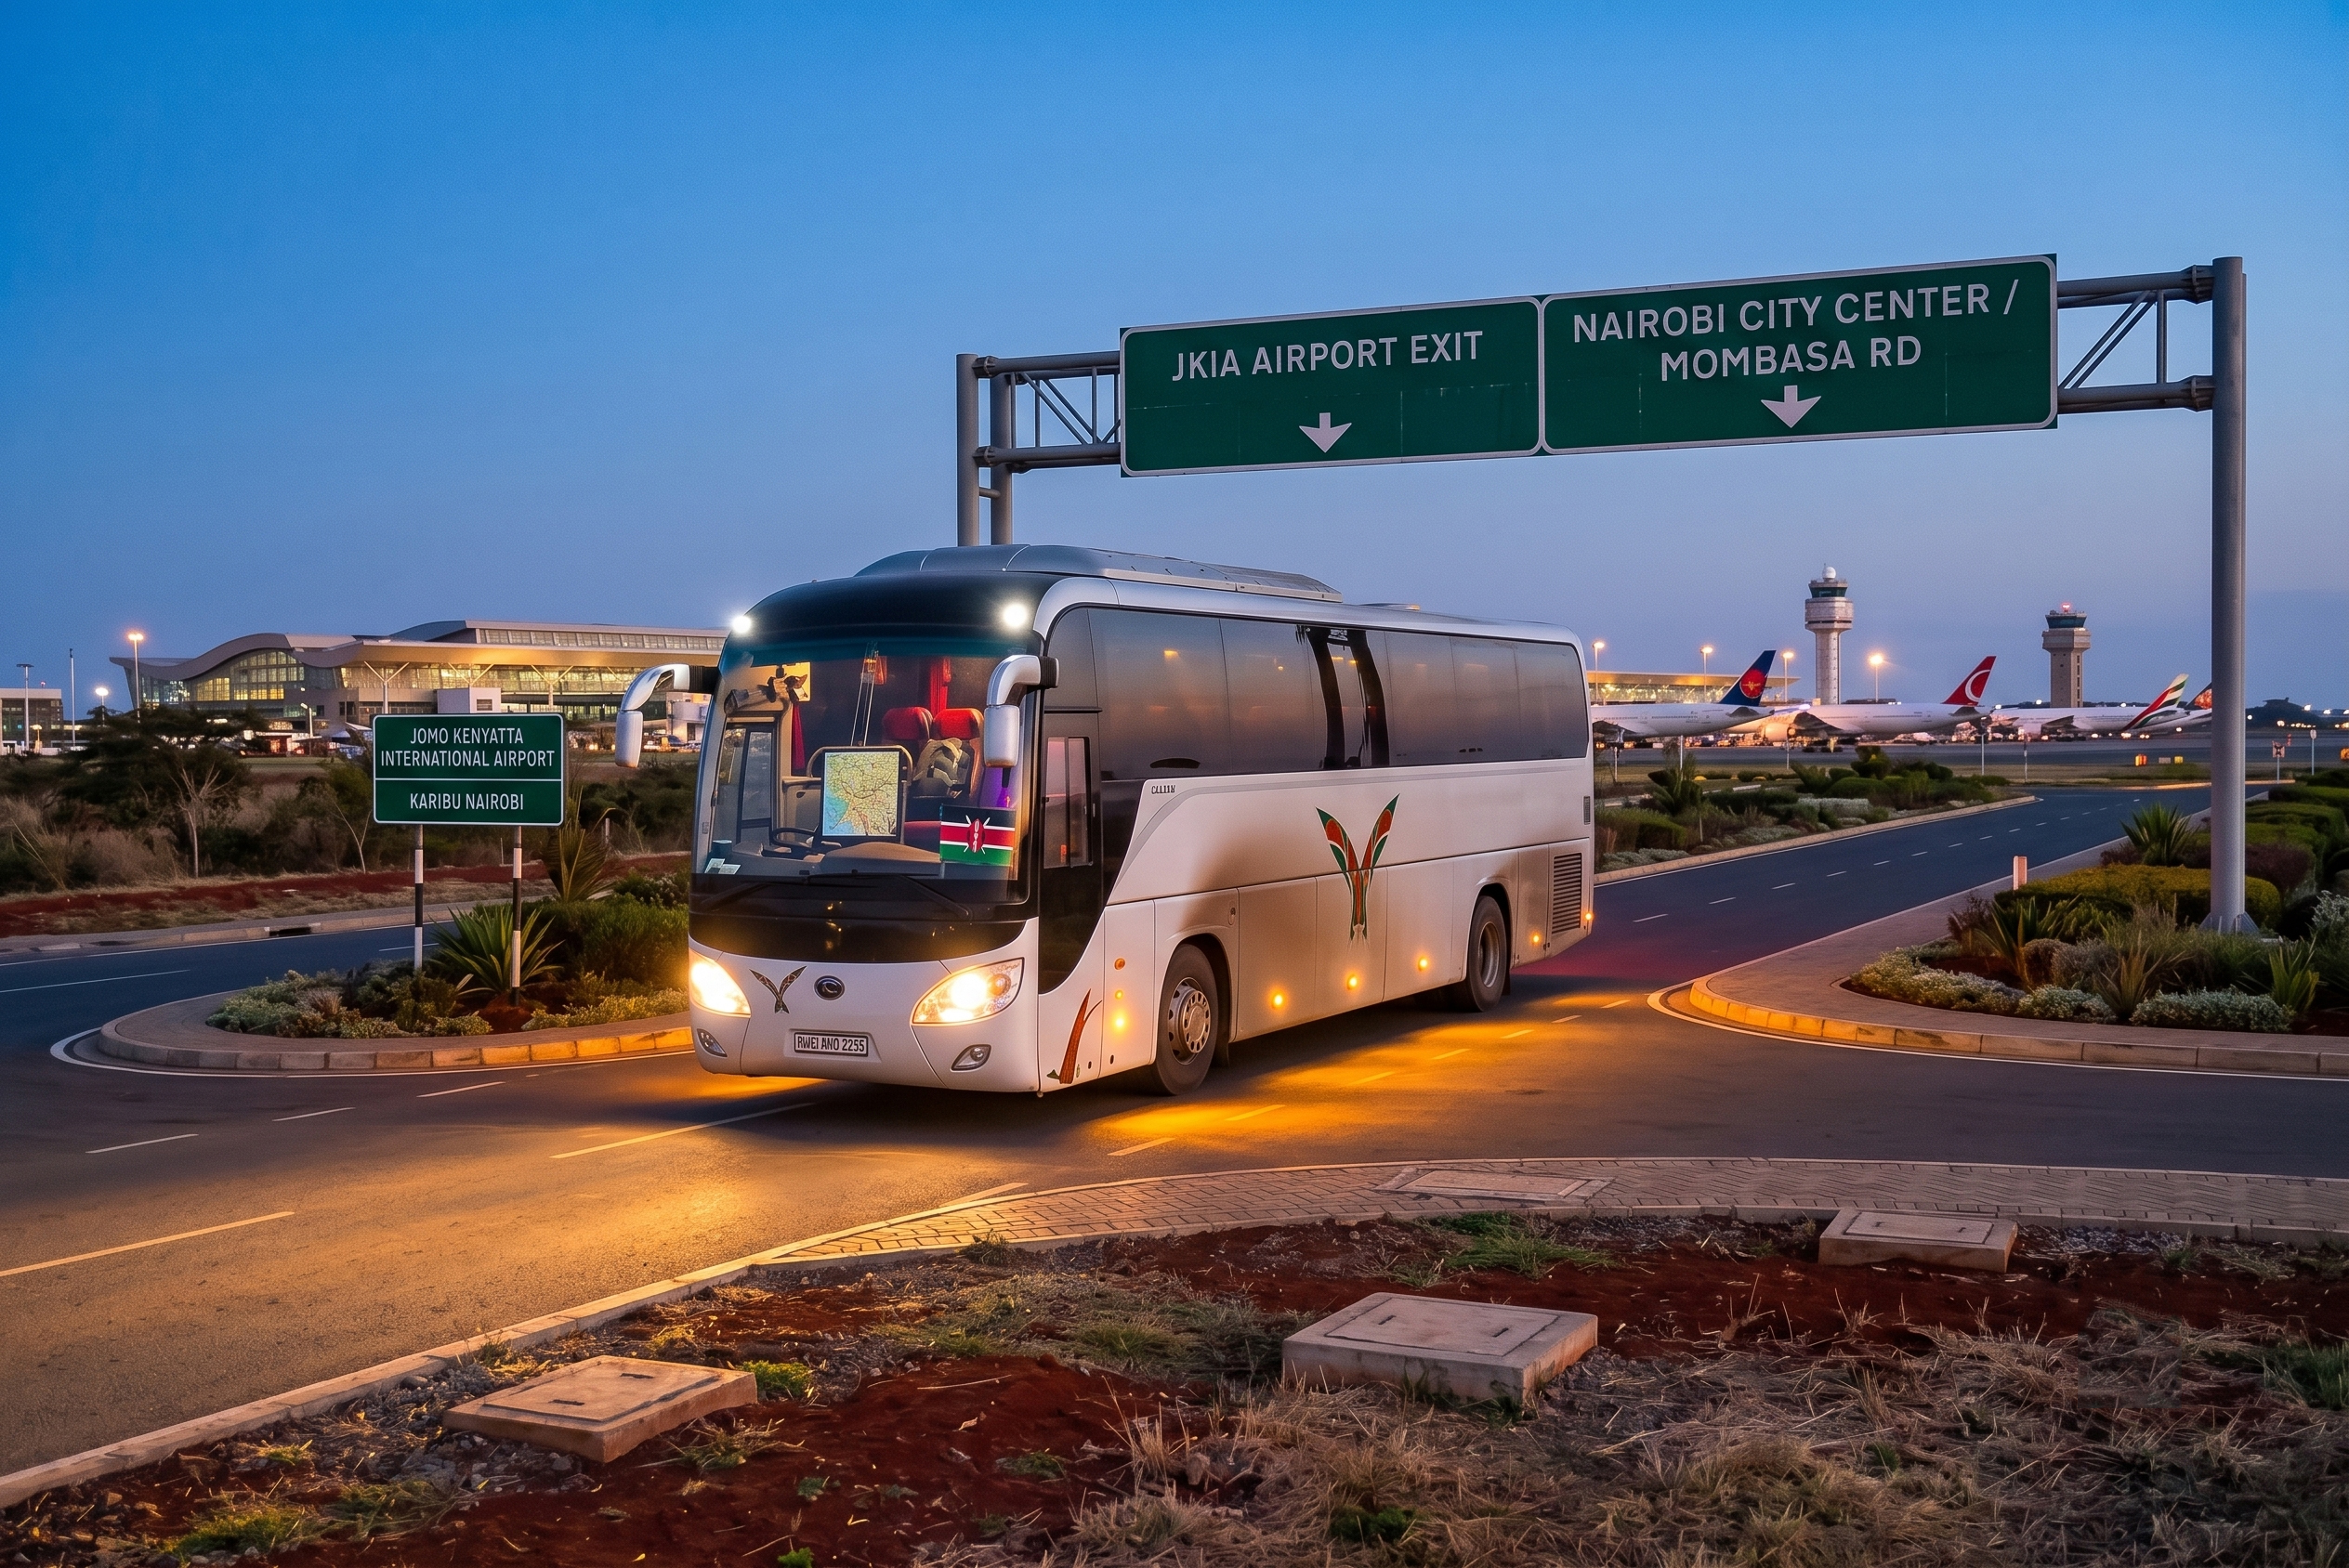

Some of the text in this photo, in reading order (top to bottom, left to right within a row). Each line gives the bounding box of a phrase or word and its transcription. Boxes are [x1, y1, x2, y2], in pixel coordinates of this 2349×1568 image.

[1574, 279, 2019, 343] NAIROBI CITY CENTER /
[1172, 330, 1483, 382] JKIA AIRPORT EXIT
[1661, 335, 1922, 382] MOMBASA RD
[410, 727, 524, 744] JOMO KENYATTA
[381, 750, 556, 767] INTERNATIONAL AIRPORT
[410, 792, 524, 810] KARIBU NAIROBI
[841, 1038, 865, 1052] 2255
